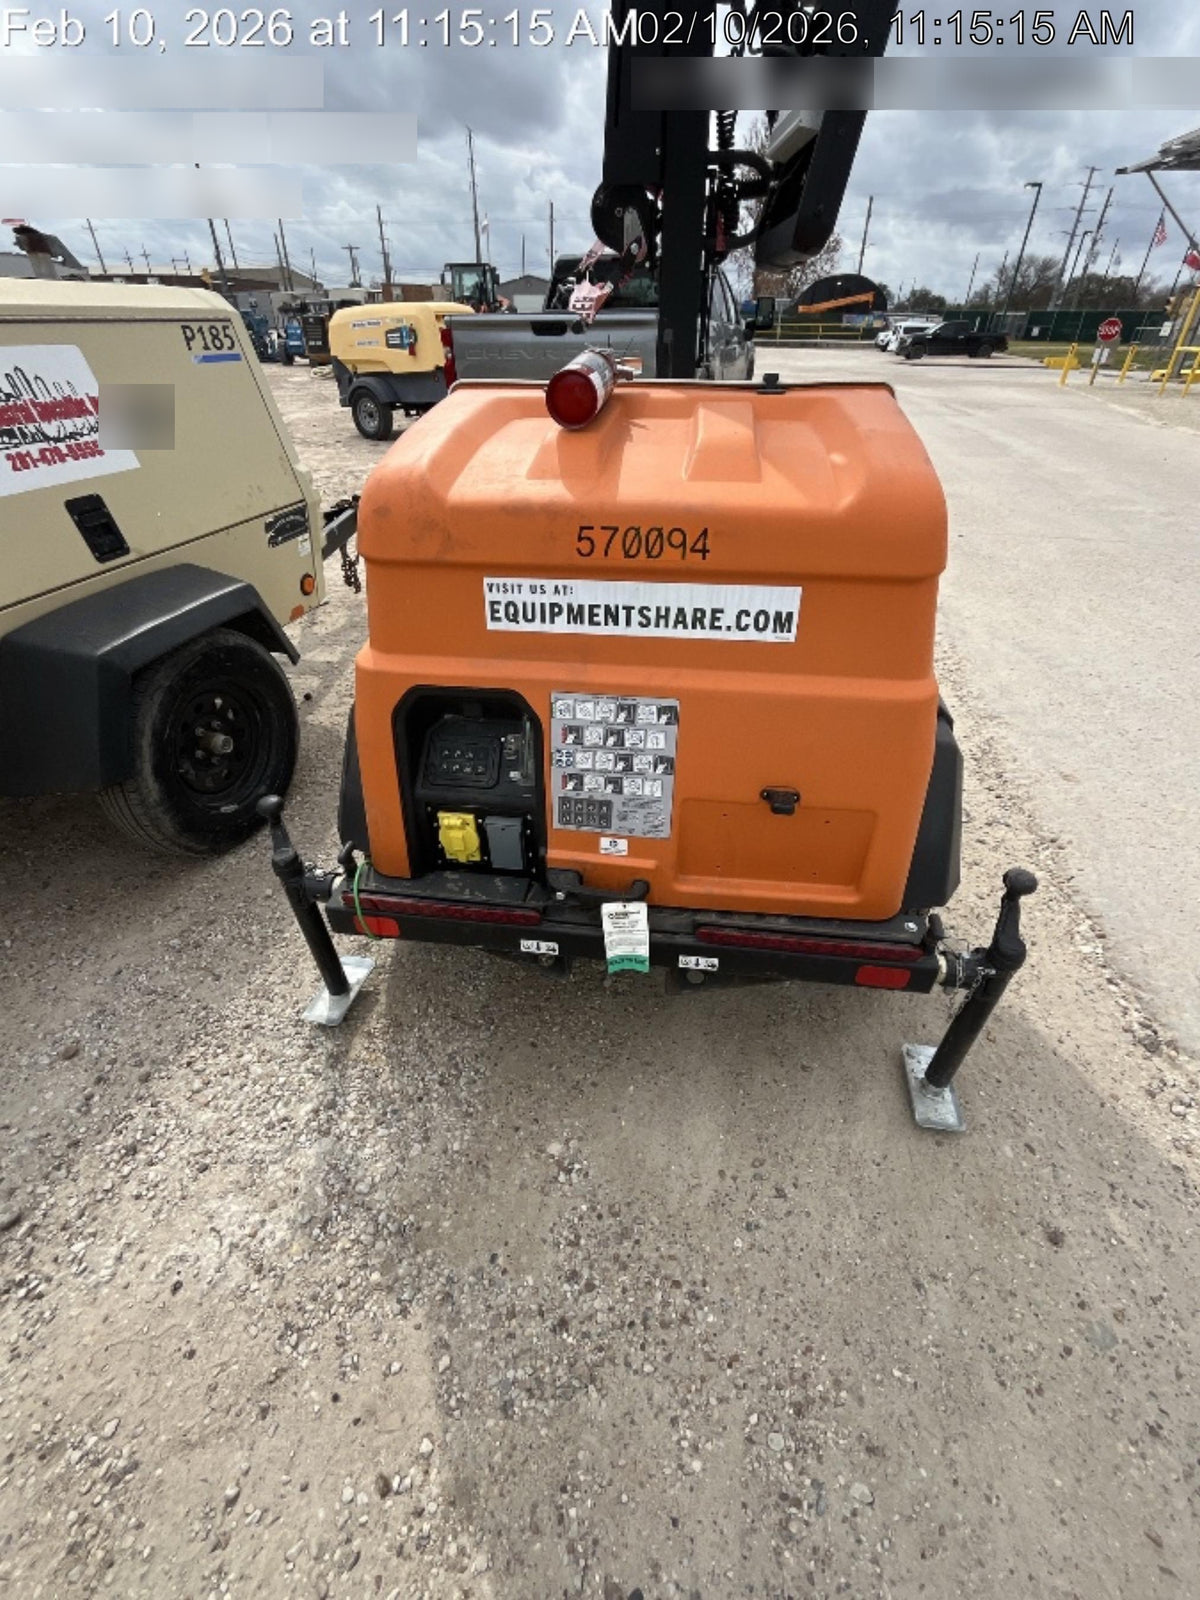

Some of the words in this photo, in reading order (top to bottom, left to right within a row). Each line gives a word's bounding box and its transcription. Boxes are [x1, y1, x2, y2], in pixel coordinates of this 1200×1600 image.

[181, 325, 235, 351] P185
[576, 526, 710, 561] 570094
[486, 582, 523, 595] VISIT
[529, 584, 547, 595] US
[553, 584, 574, 597] AT:
[488, 600, 794, 634] EQUIPMENTSHARE.COM
